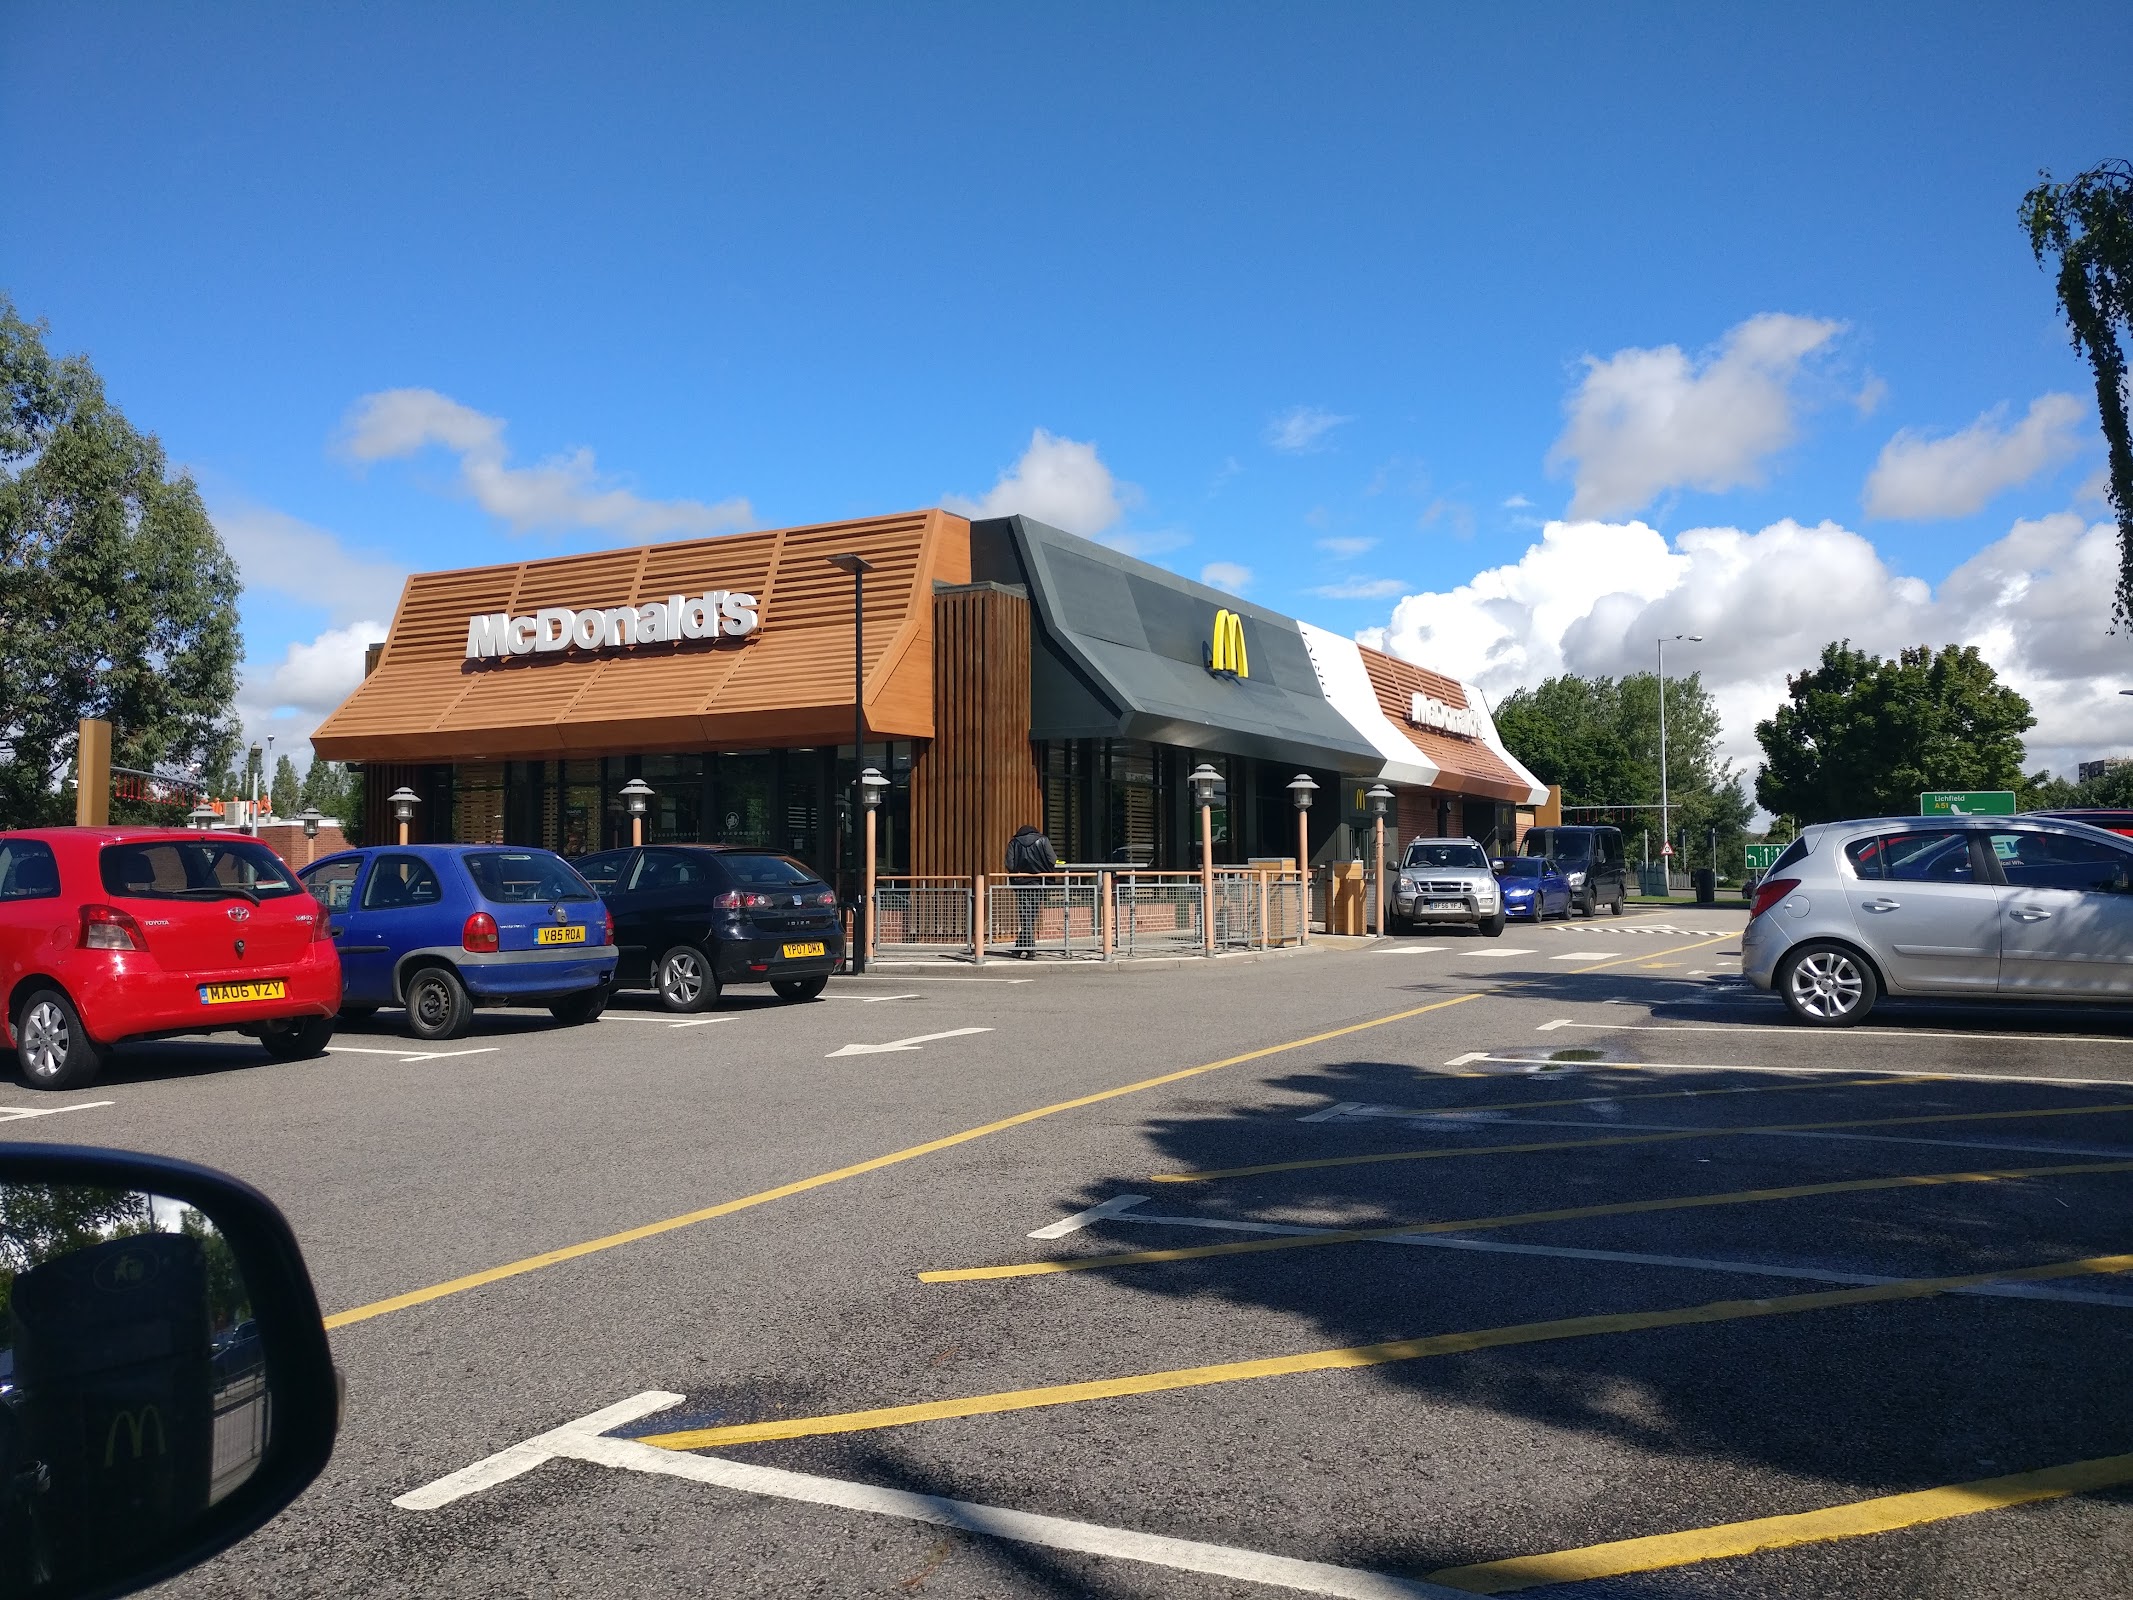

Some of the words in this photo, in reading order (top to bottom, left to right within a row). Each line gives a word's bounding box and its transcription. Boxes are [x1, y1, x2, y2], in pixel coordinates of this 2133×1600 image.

[466, 590, 758, 658] McDonald's
[544, 929, 563, 941] V85
[787, 944, 806, 955] YP07
[210, 985, 250, 1000] MA06
[253, 981, 280, 997] VZY
